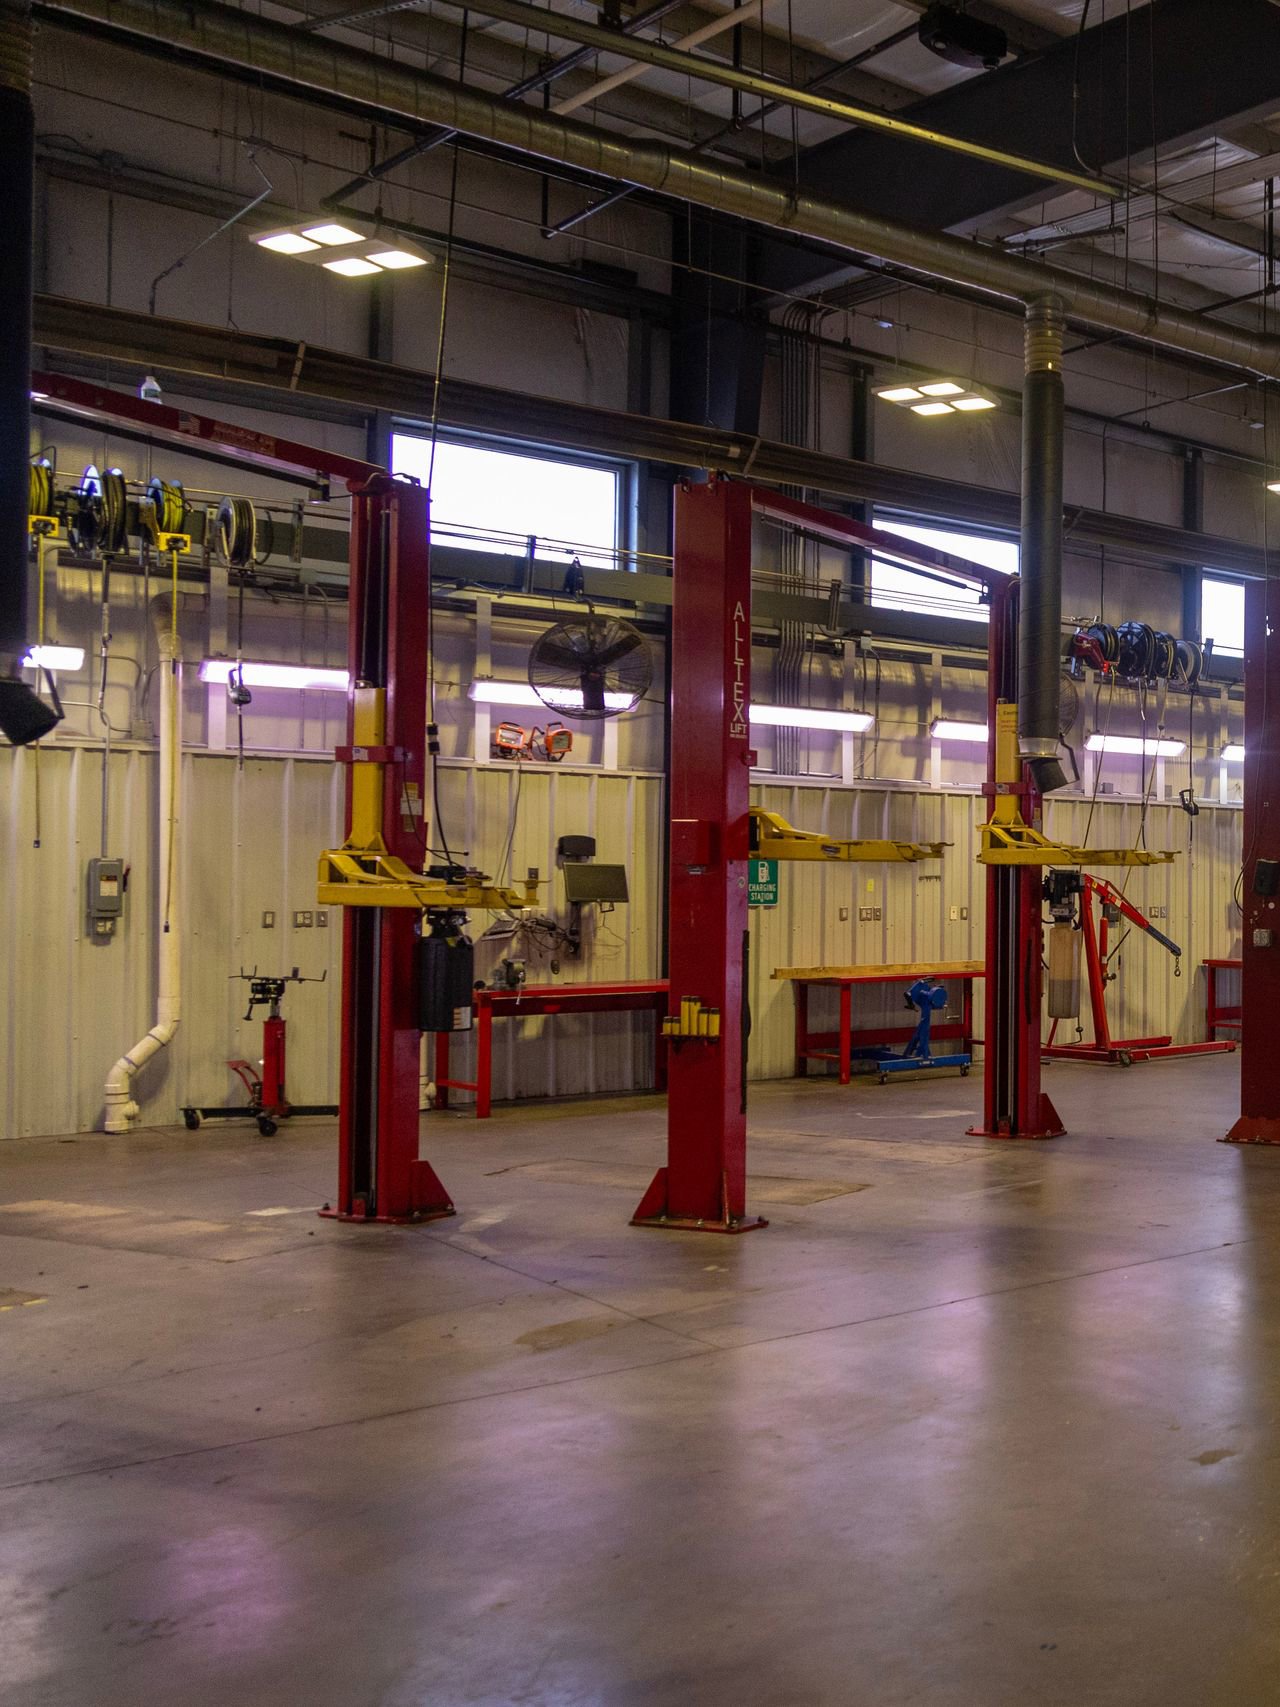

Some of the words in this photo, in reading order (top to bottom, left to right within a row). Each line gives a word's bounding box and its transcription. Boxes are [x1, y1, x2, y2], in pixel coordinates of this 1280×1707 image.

[733, 601, 745, 722] ALLTEX
[730, 722, 747, 734] LIFT
[748, 883, 776, 892] CHARGING
[750, 892, 774, 901] STATION
